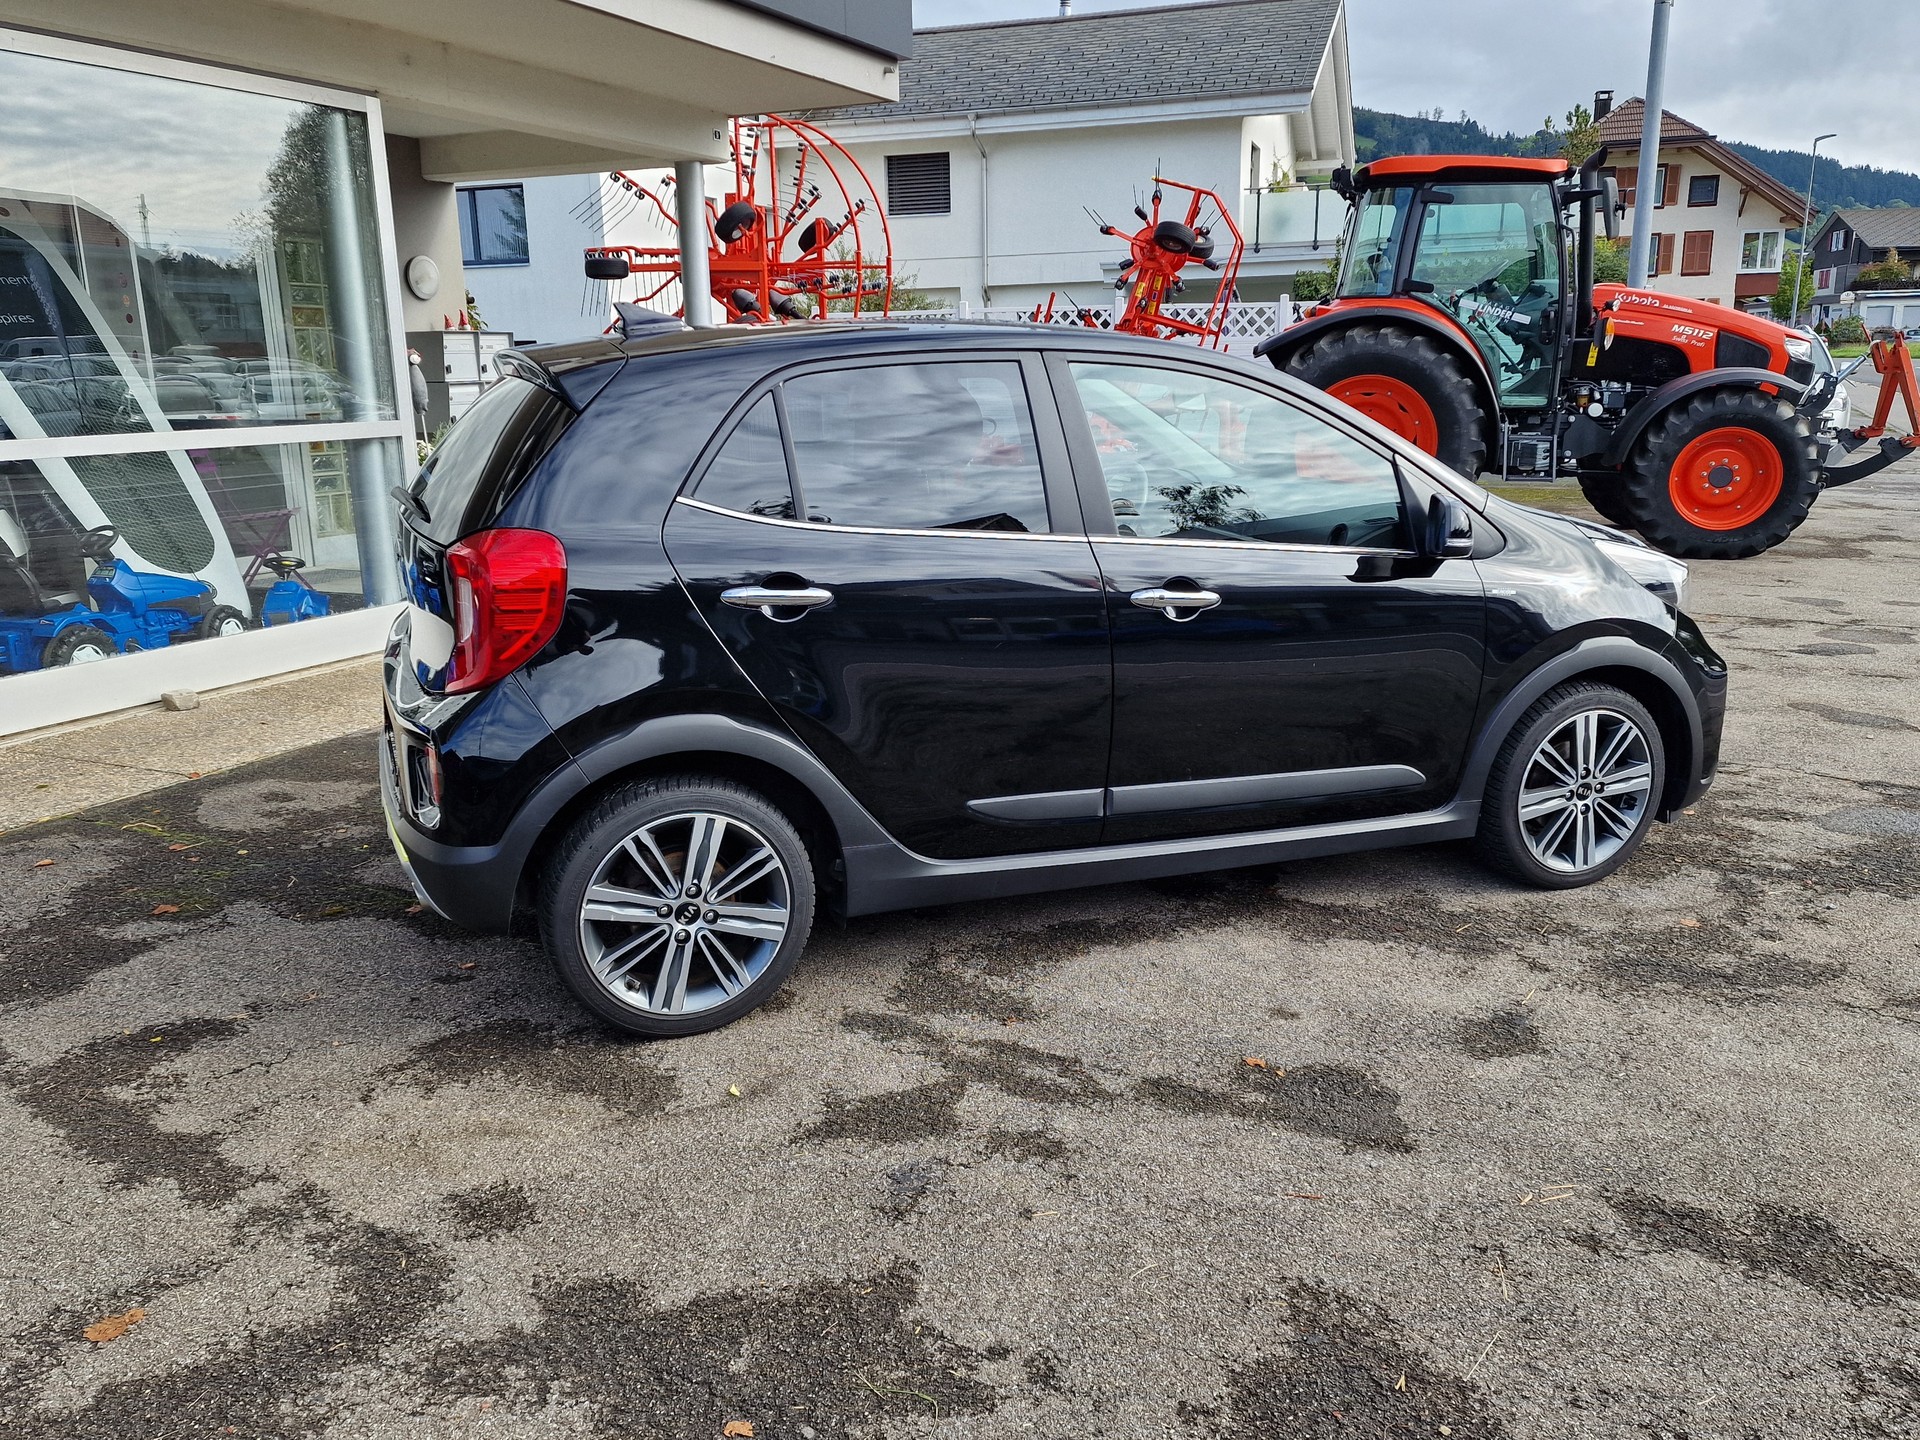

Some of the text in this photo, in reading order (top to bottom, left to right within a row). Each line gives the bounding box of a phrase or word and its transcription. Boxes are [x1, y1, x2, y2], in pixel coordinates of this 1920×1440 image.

[1615, 292, 1660, 307] Kubota
[1478, 304, 1512, 319] LINDER
[1577, 786, 1592, 797] KIA
[678, 905, 698, 925] KIA
